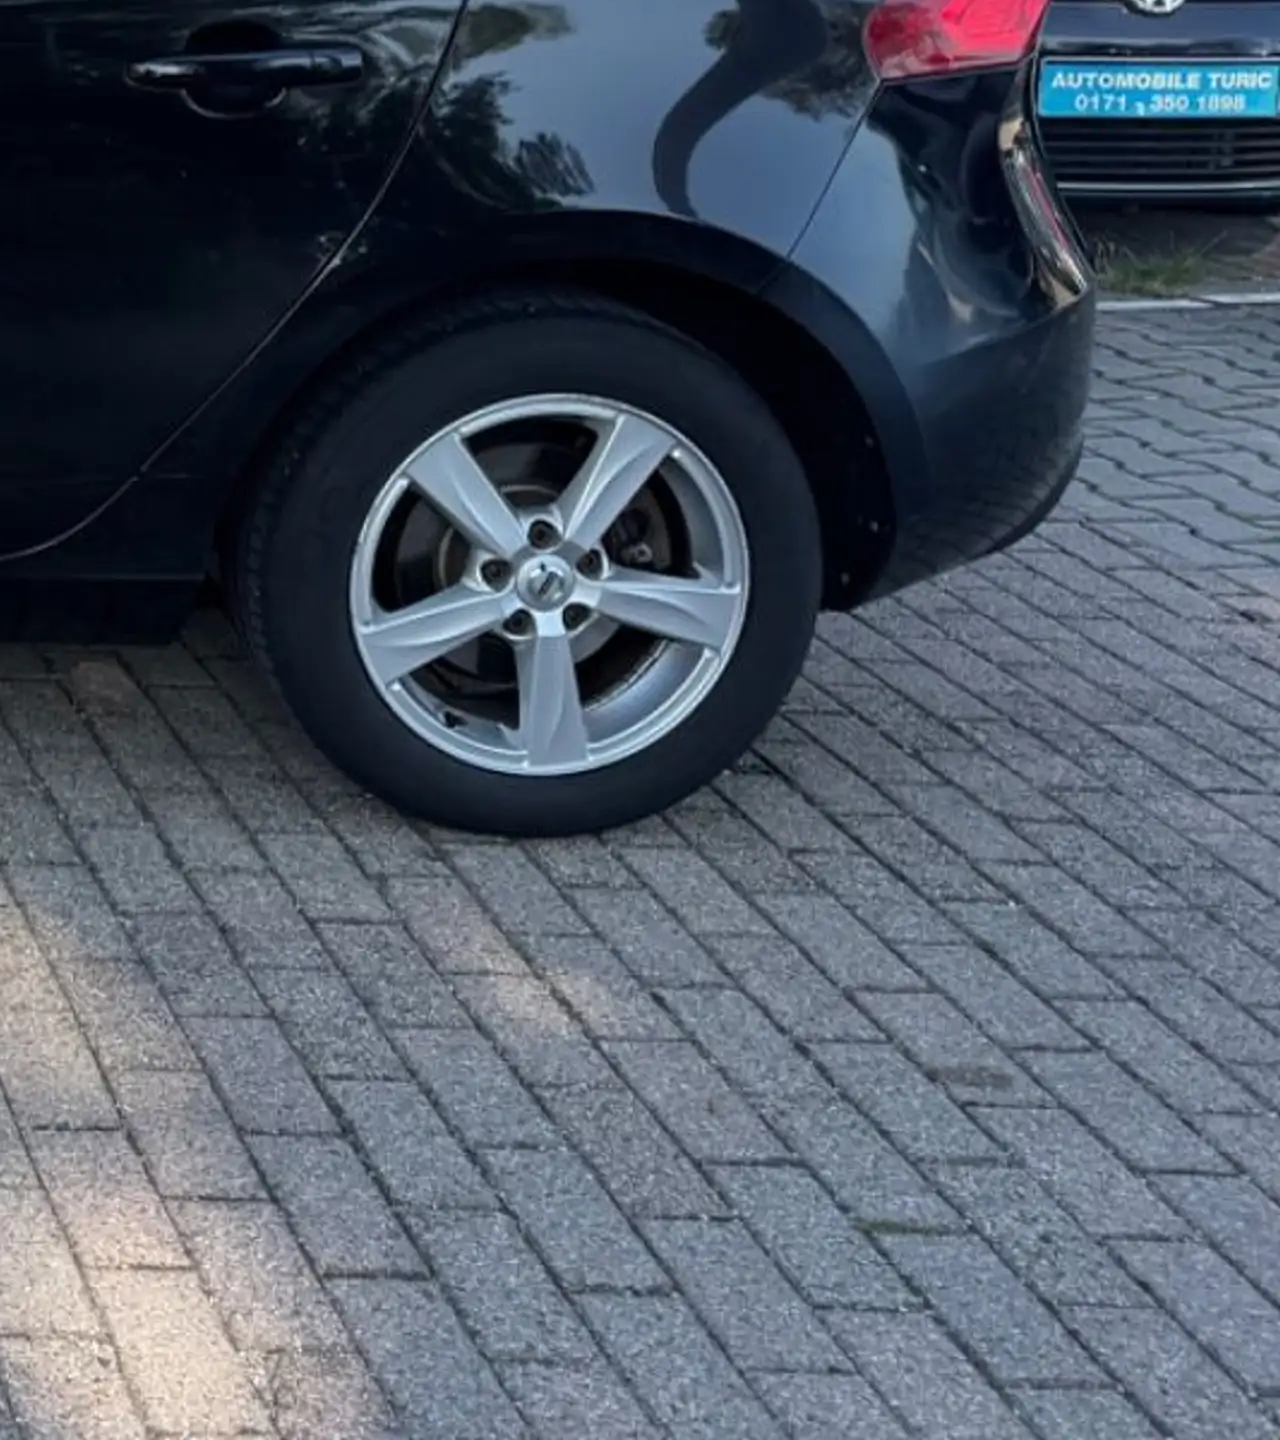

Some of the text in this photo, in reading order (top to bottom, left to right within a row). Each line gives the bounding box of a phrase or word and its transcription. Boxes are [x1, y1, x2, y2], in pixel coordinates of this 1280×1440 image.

[1051, 71, 1273, 90] AUTOMOBILE TURIC
[1074, 92, 1127, 111] 0171
[1149, 93, 1190, 110] 350
